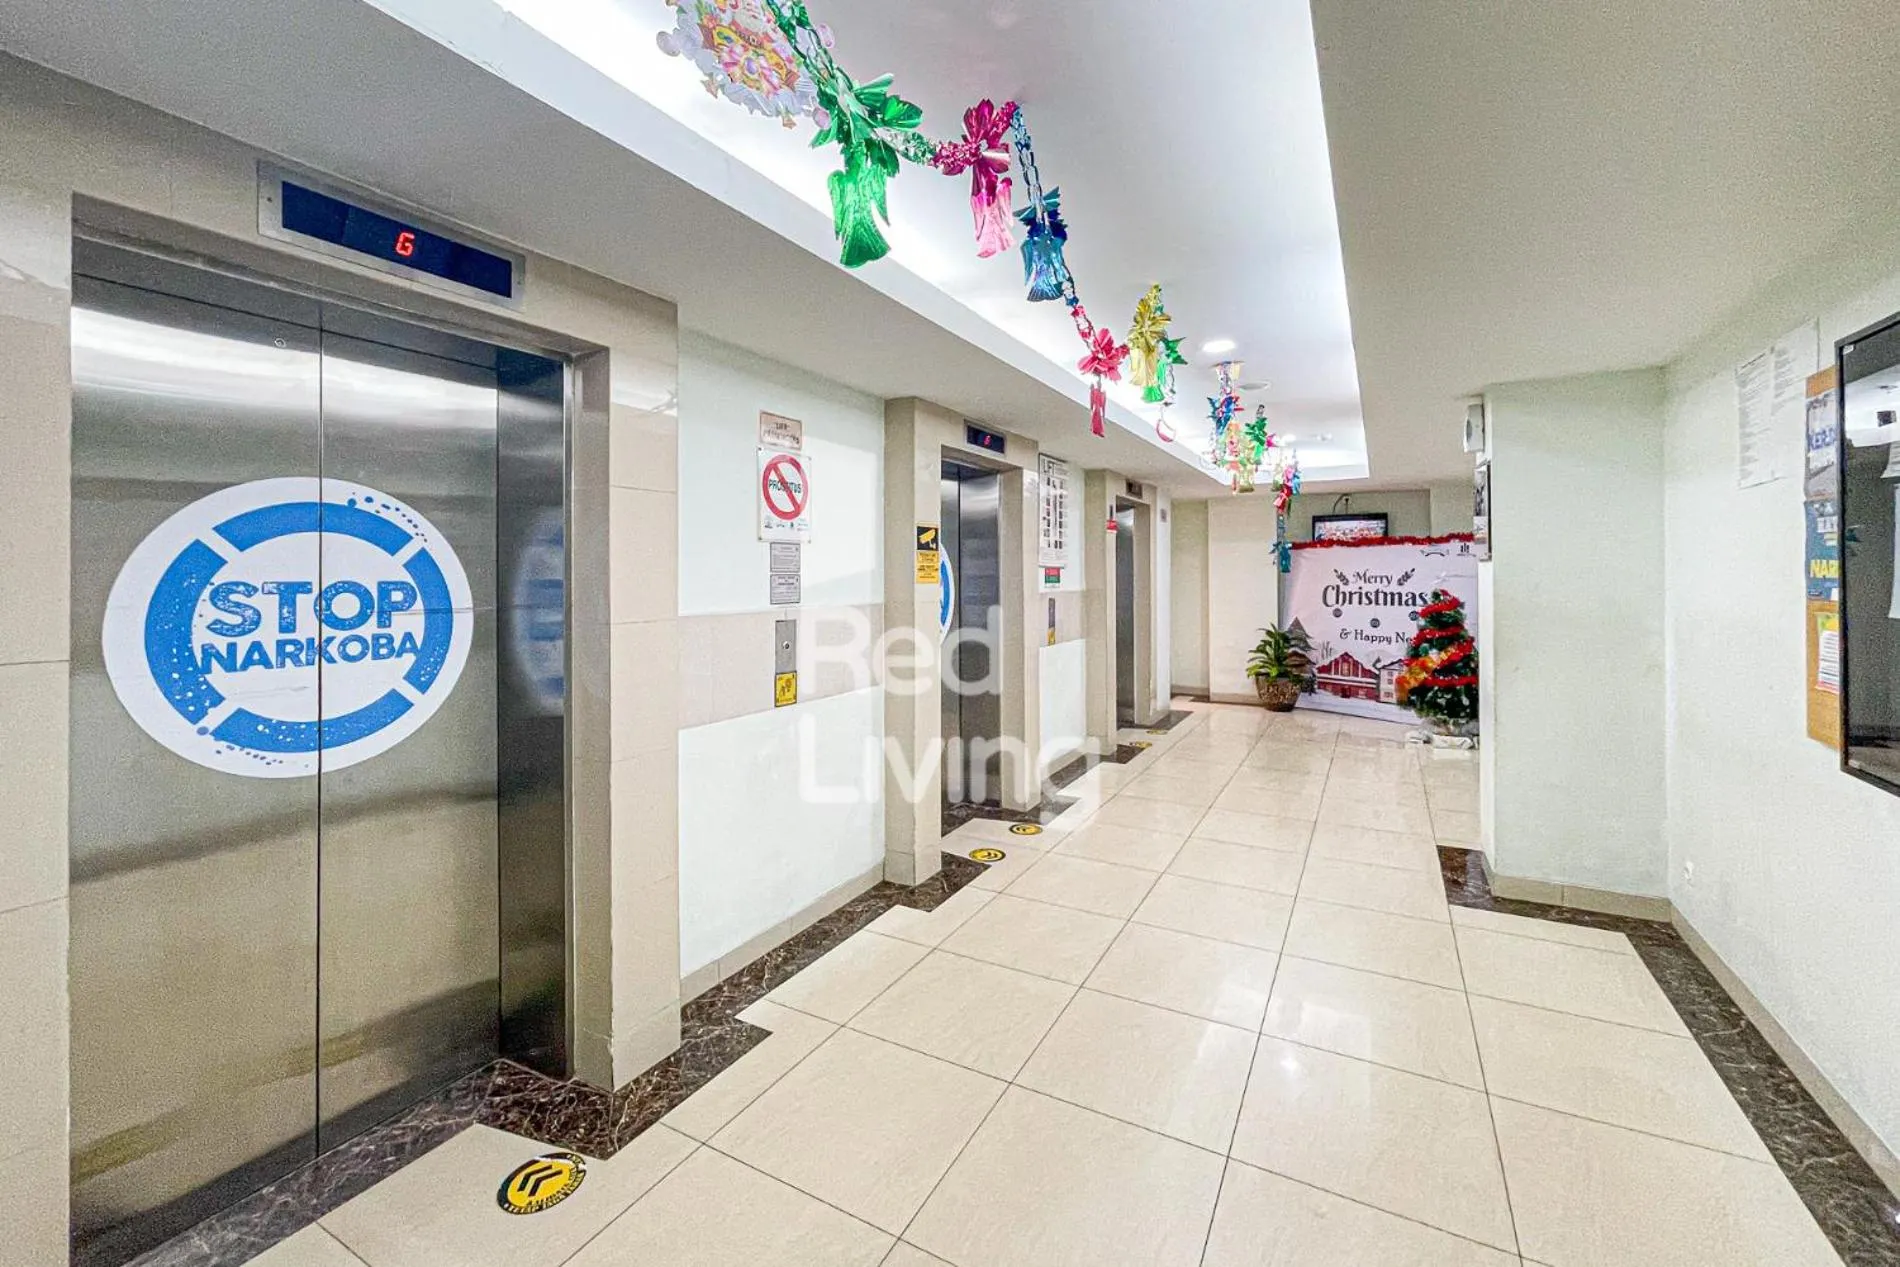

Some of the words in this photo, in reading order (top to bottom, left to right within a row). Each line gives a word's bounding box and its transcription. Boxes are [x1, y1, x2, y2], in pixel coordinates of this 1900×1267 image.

[395, 231, 416, 257] G
[1352, 570, 1393, 587] Merry
[206, 580, 418, 637] STOP
[1322, 584, 1429, 608] Christmas
[1339, 628, 1351, 639] &
[1354, 629, 1392, 644] Happy
[1395, 631, 1412, 643] Ne
[200, 631, 420, 674] NARKOBA
